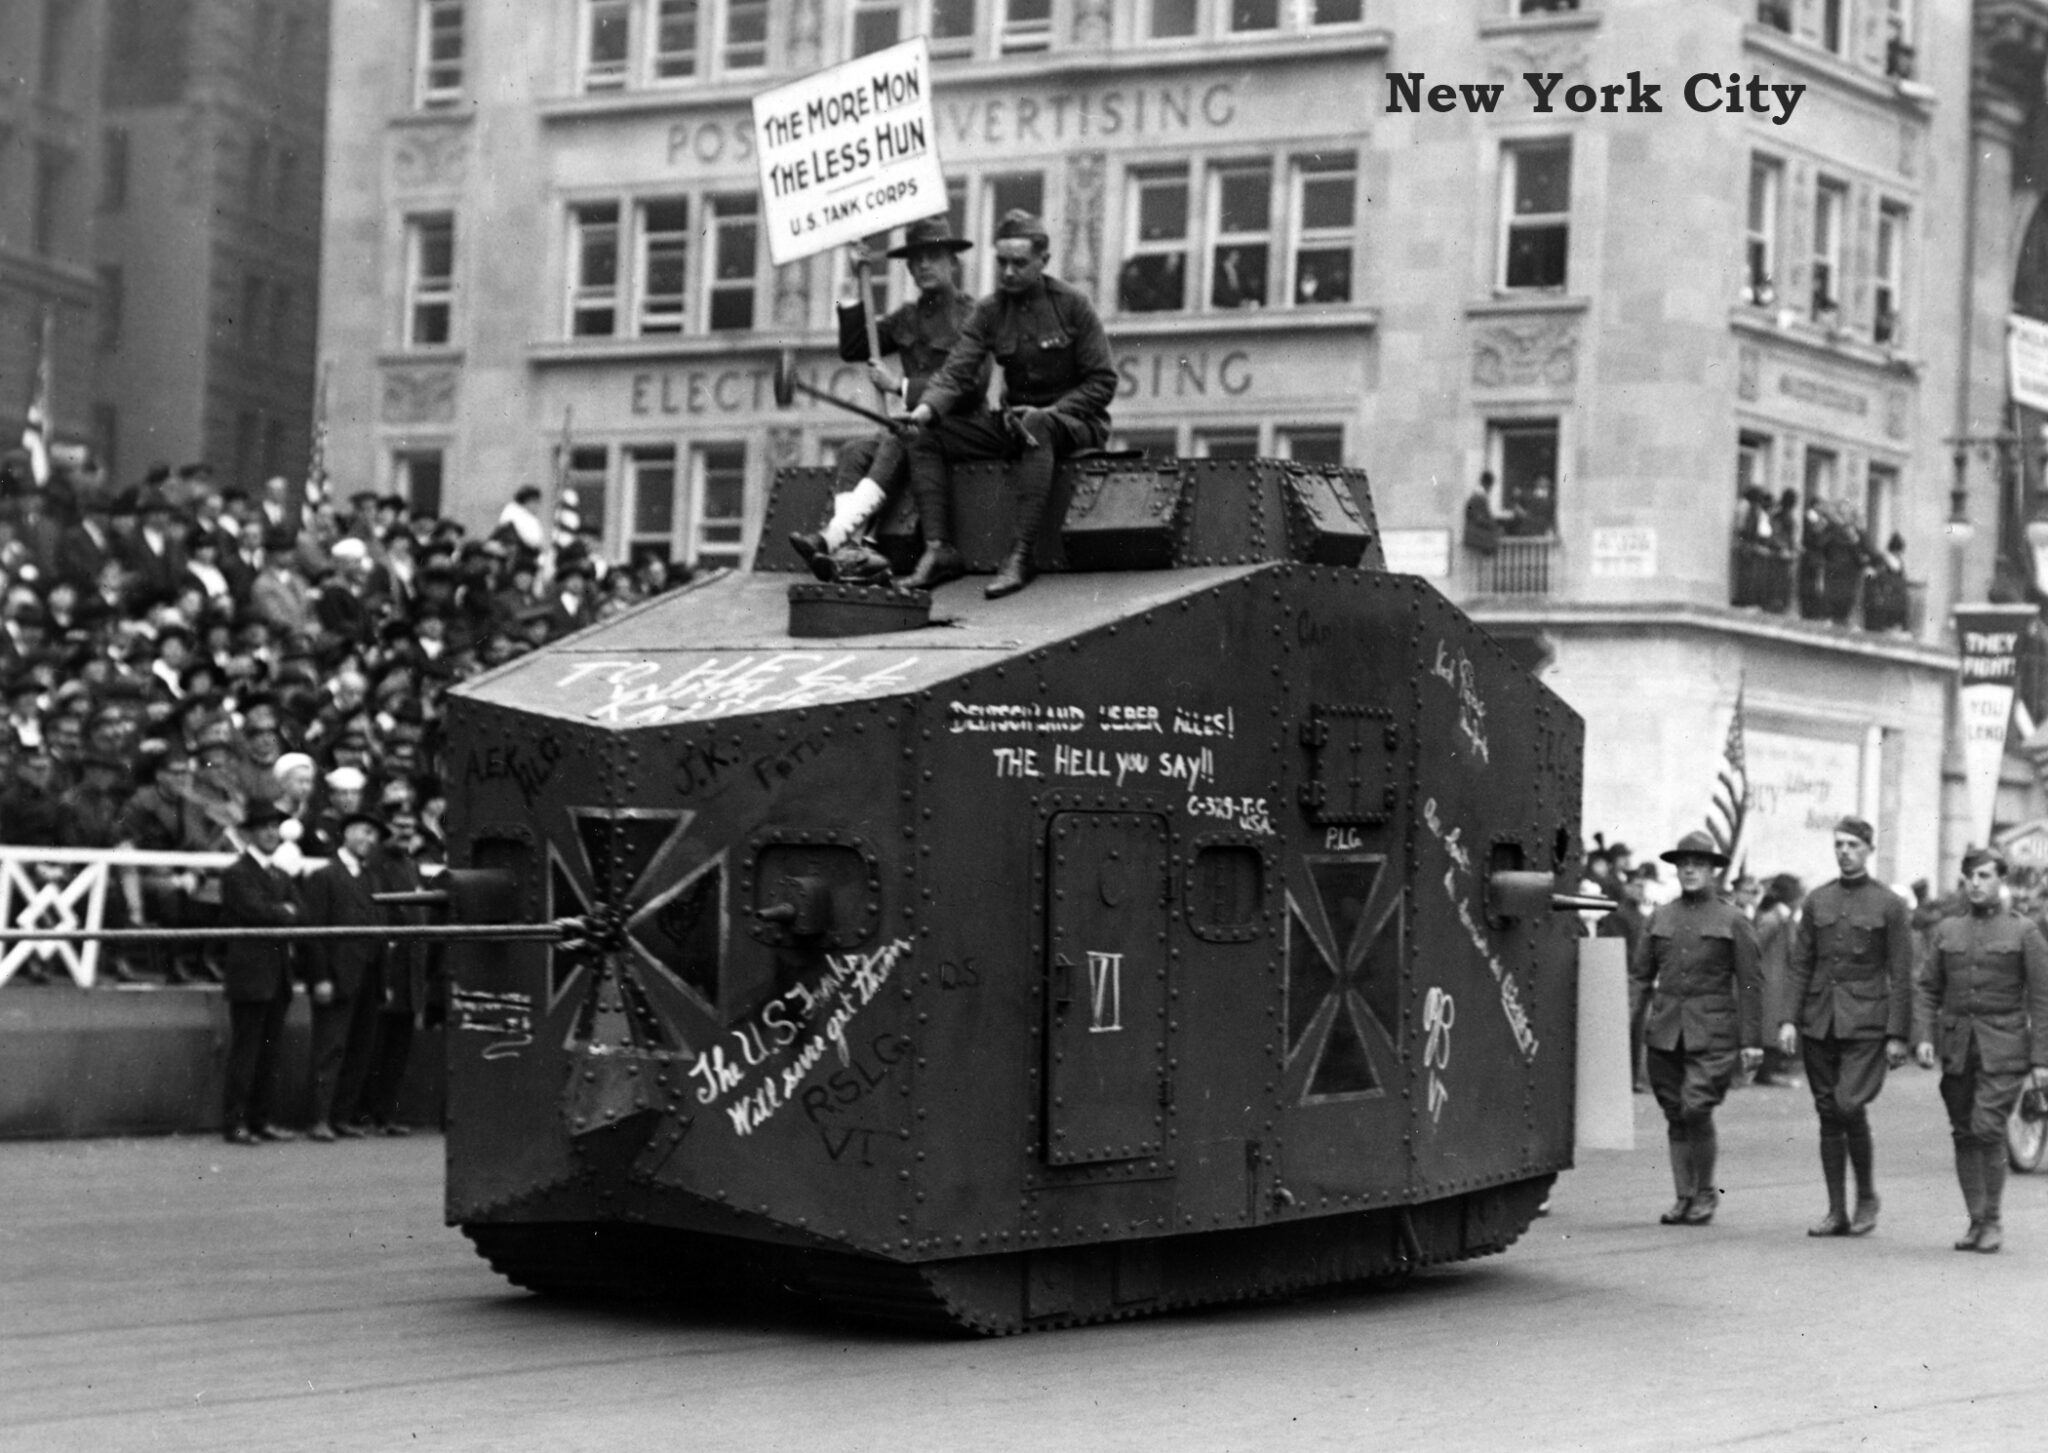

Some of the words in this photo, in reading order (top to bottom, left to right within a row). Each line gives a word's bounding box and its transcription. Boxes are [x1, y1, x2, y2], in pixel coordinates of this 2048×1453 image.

[764, 111, 802, 148] THE
[807, 87, 870, 134] MORE
[770, 160, 809, 197] THE
[813, 138, 870, 184] LESS
[875, 117, 926, 161] HUN
[823, 200, 861, 224] TANK
[865, 178, 918, 210] CORPS
[631, 366, 868, 416] ELECTIC
[1966, 631, 2018, 653] THEY
[993, 747, 1043, 778] THE
[1054, 744, 1111, 777] HELL
[1086, 951, 1124, 1033] VI
[688, 1045, 745, 1104] The
[731, 1000, 806, 1066] U.S.
[726, 1077, 783, 1136] Will
